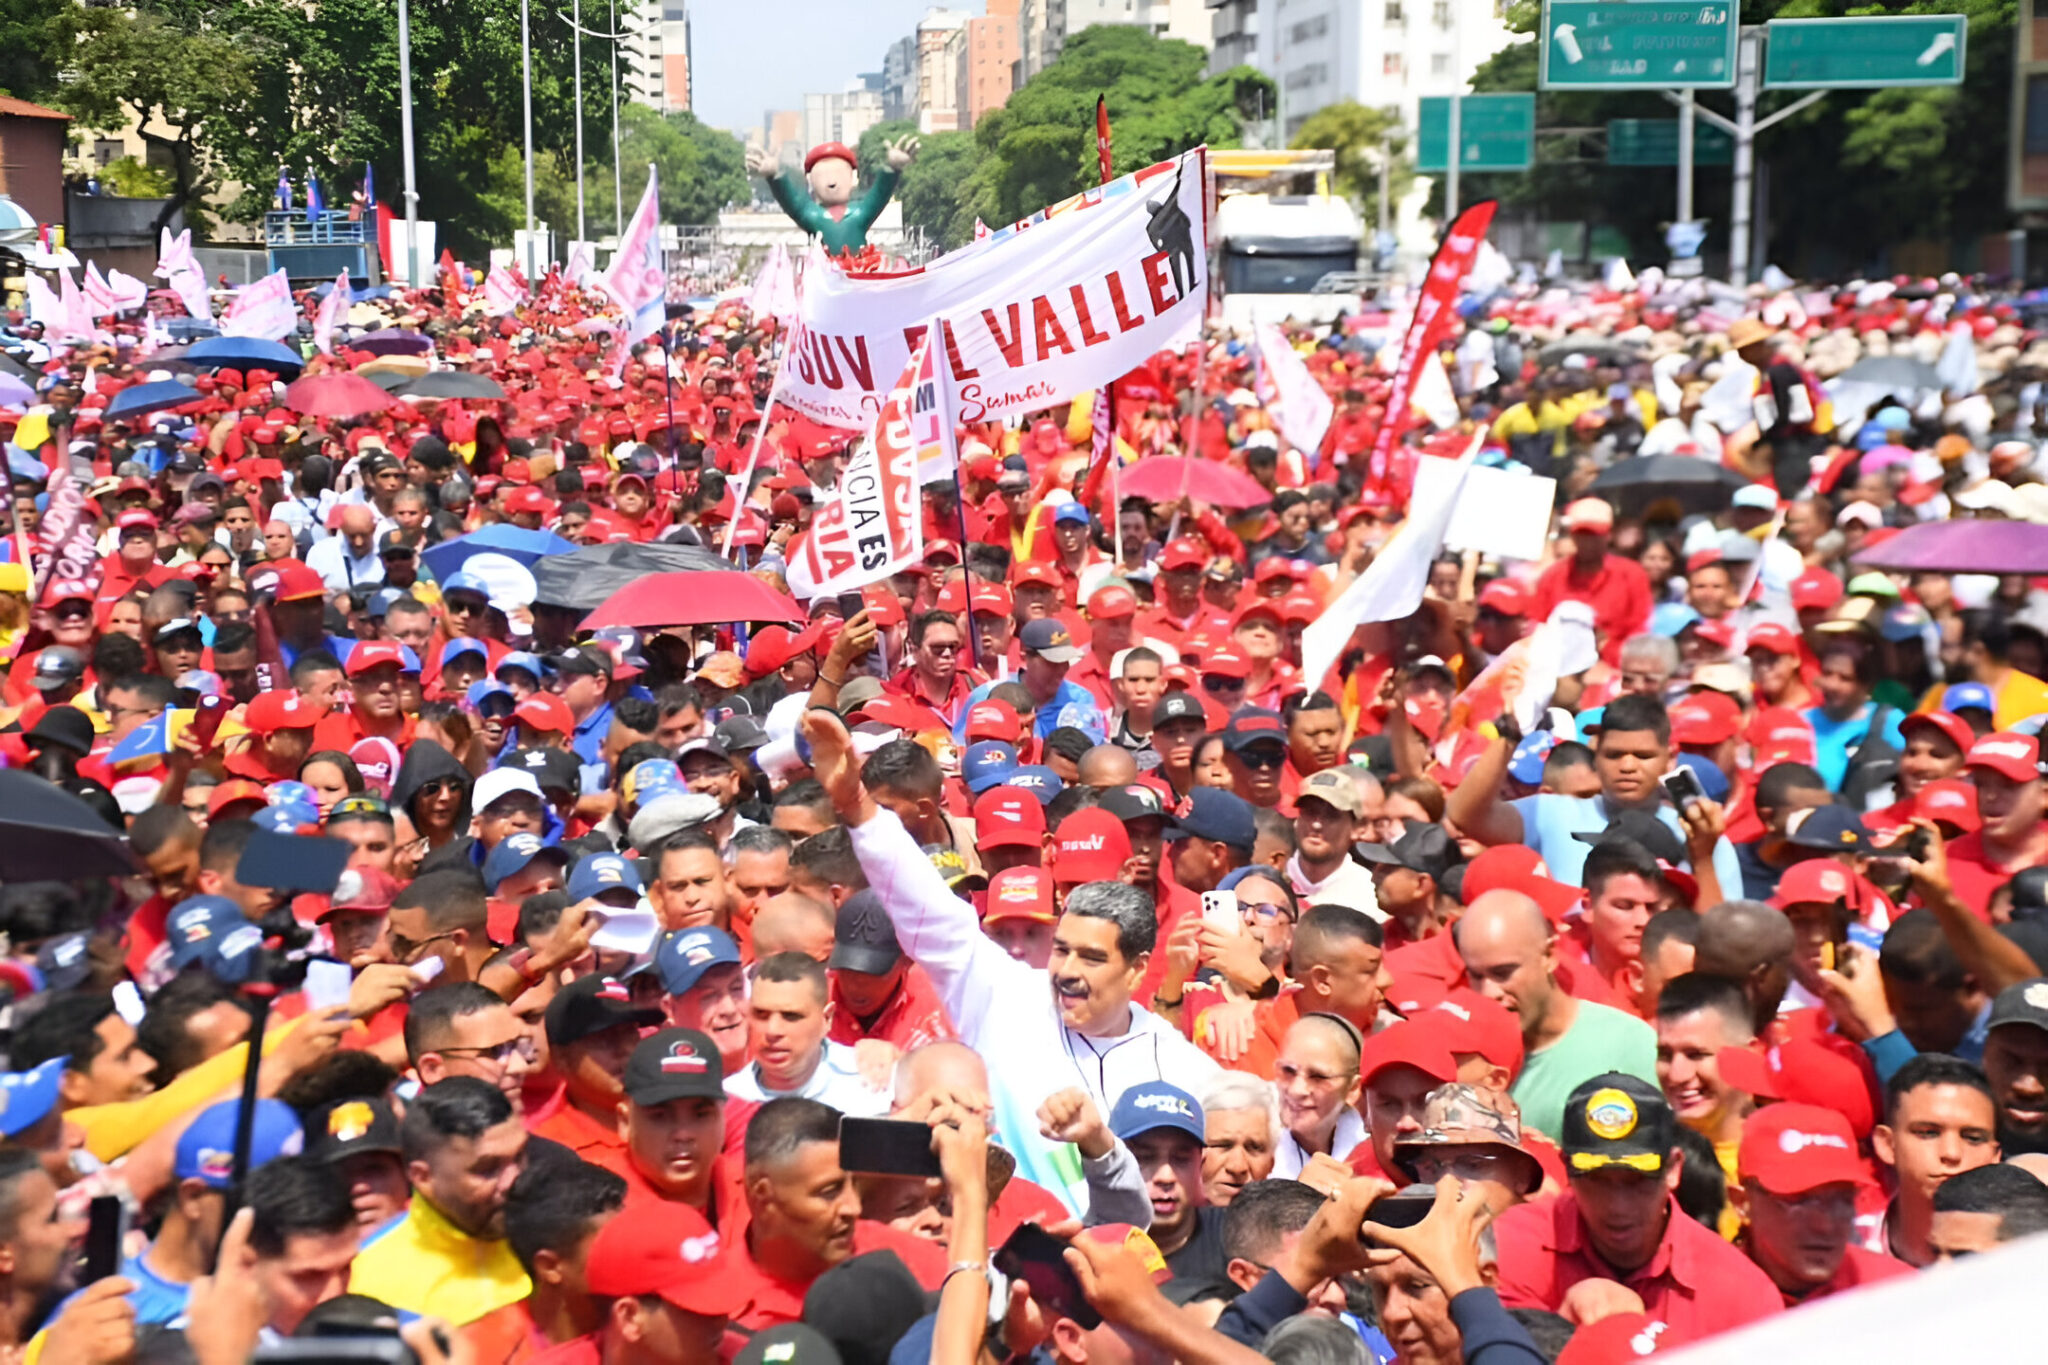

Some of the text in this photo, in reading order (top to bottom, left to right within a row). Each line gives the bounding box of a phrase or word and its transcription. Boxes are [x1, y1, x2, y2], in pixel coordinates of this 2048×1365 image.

[788, 323, 875, 391] SUV
[980, 250, 1180, 369] VALLE
[811, 498, 857, 580] RIA
[858, 533, 887, 572] ES
